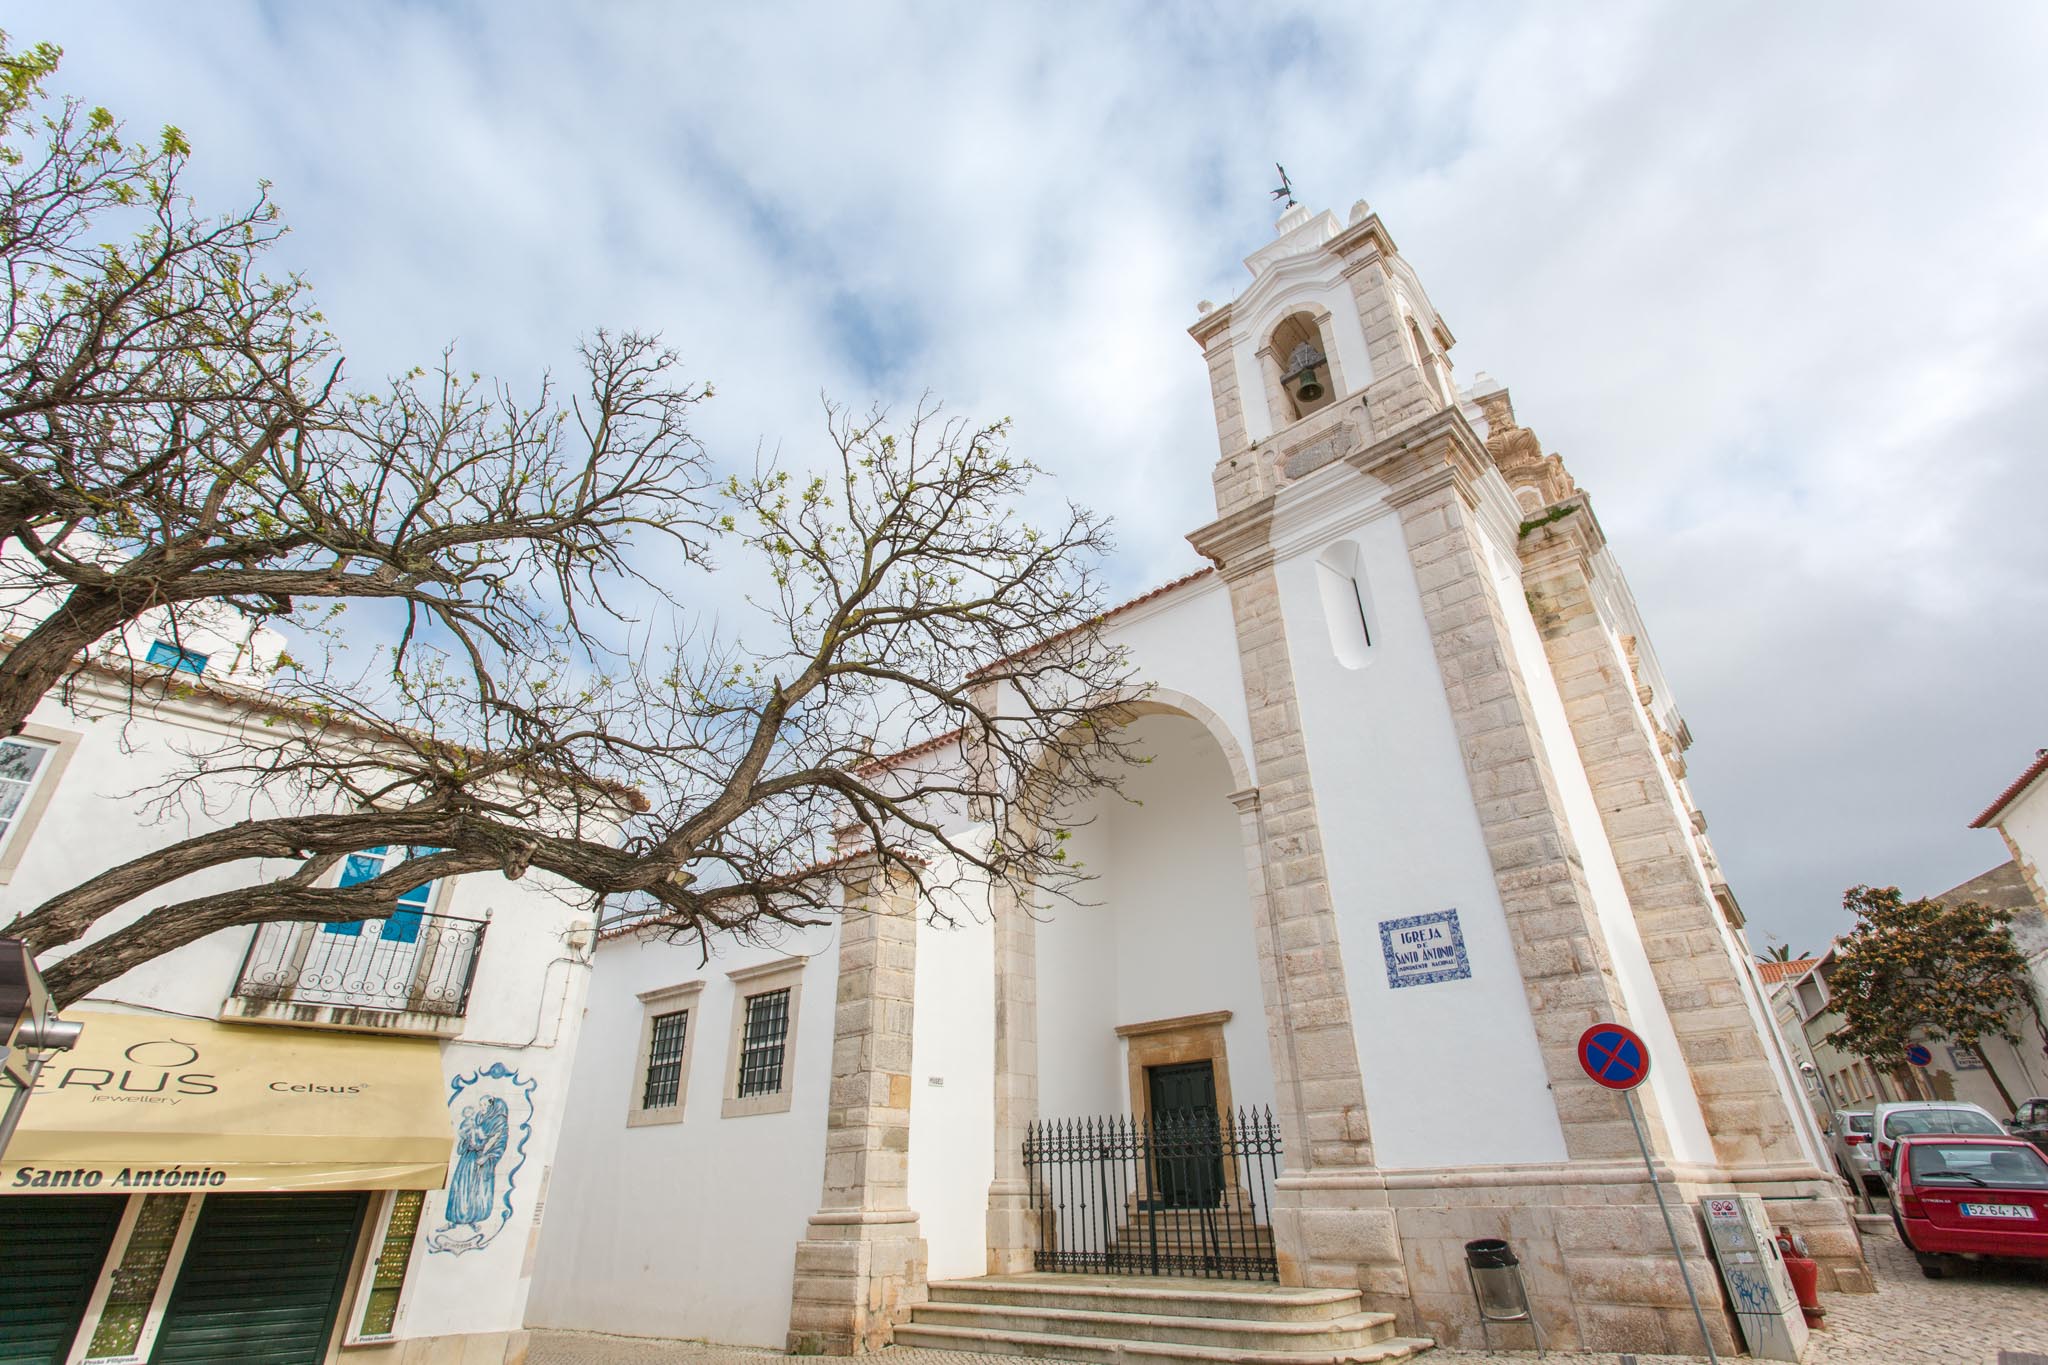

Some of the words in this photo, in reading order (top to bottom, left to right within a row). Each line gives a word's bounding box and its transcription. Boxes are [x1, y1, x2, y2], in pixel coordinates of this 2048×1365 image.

[1400, 927, 1442, 944] IGREJA
[1395, 951, 1419, 965] SANTO
[268, 1081, 361, 1094] Celsus
[90, 1094, 184, 1105] jewellery
[12, 1166, 103, 1188] Santo
[111, 1165, 227, 1188] António
